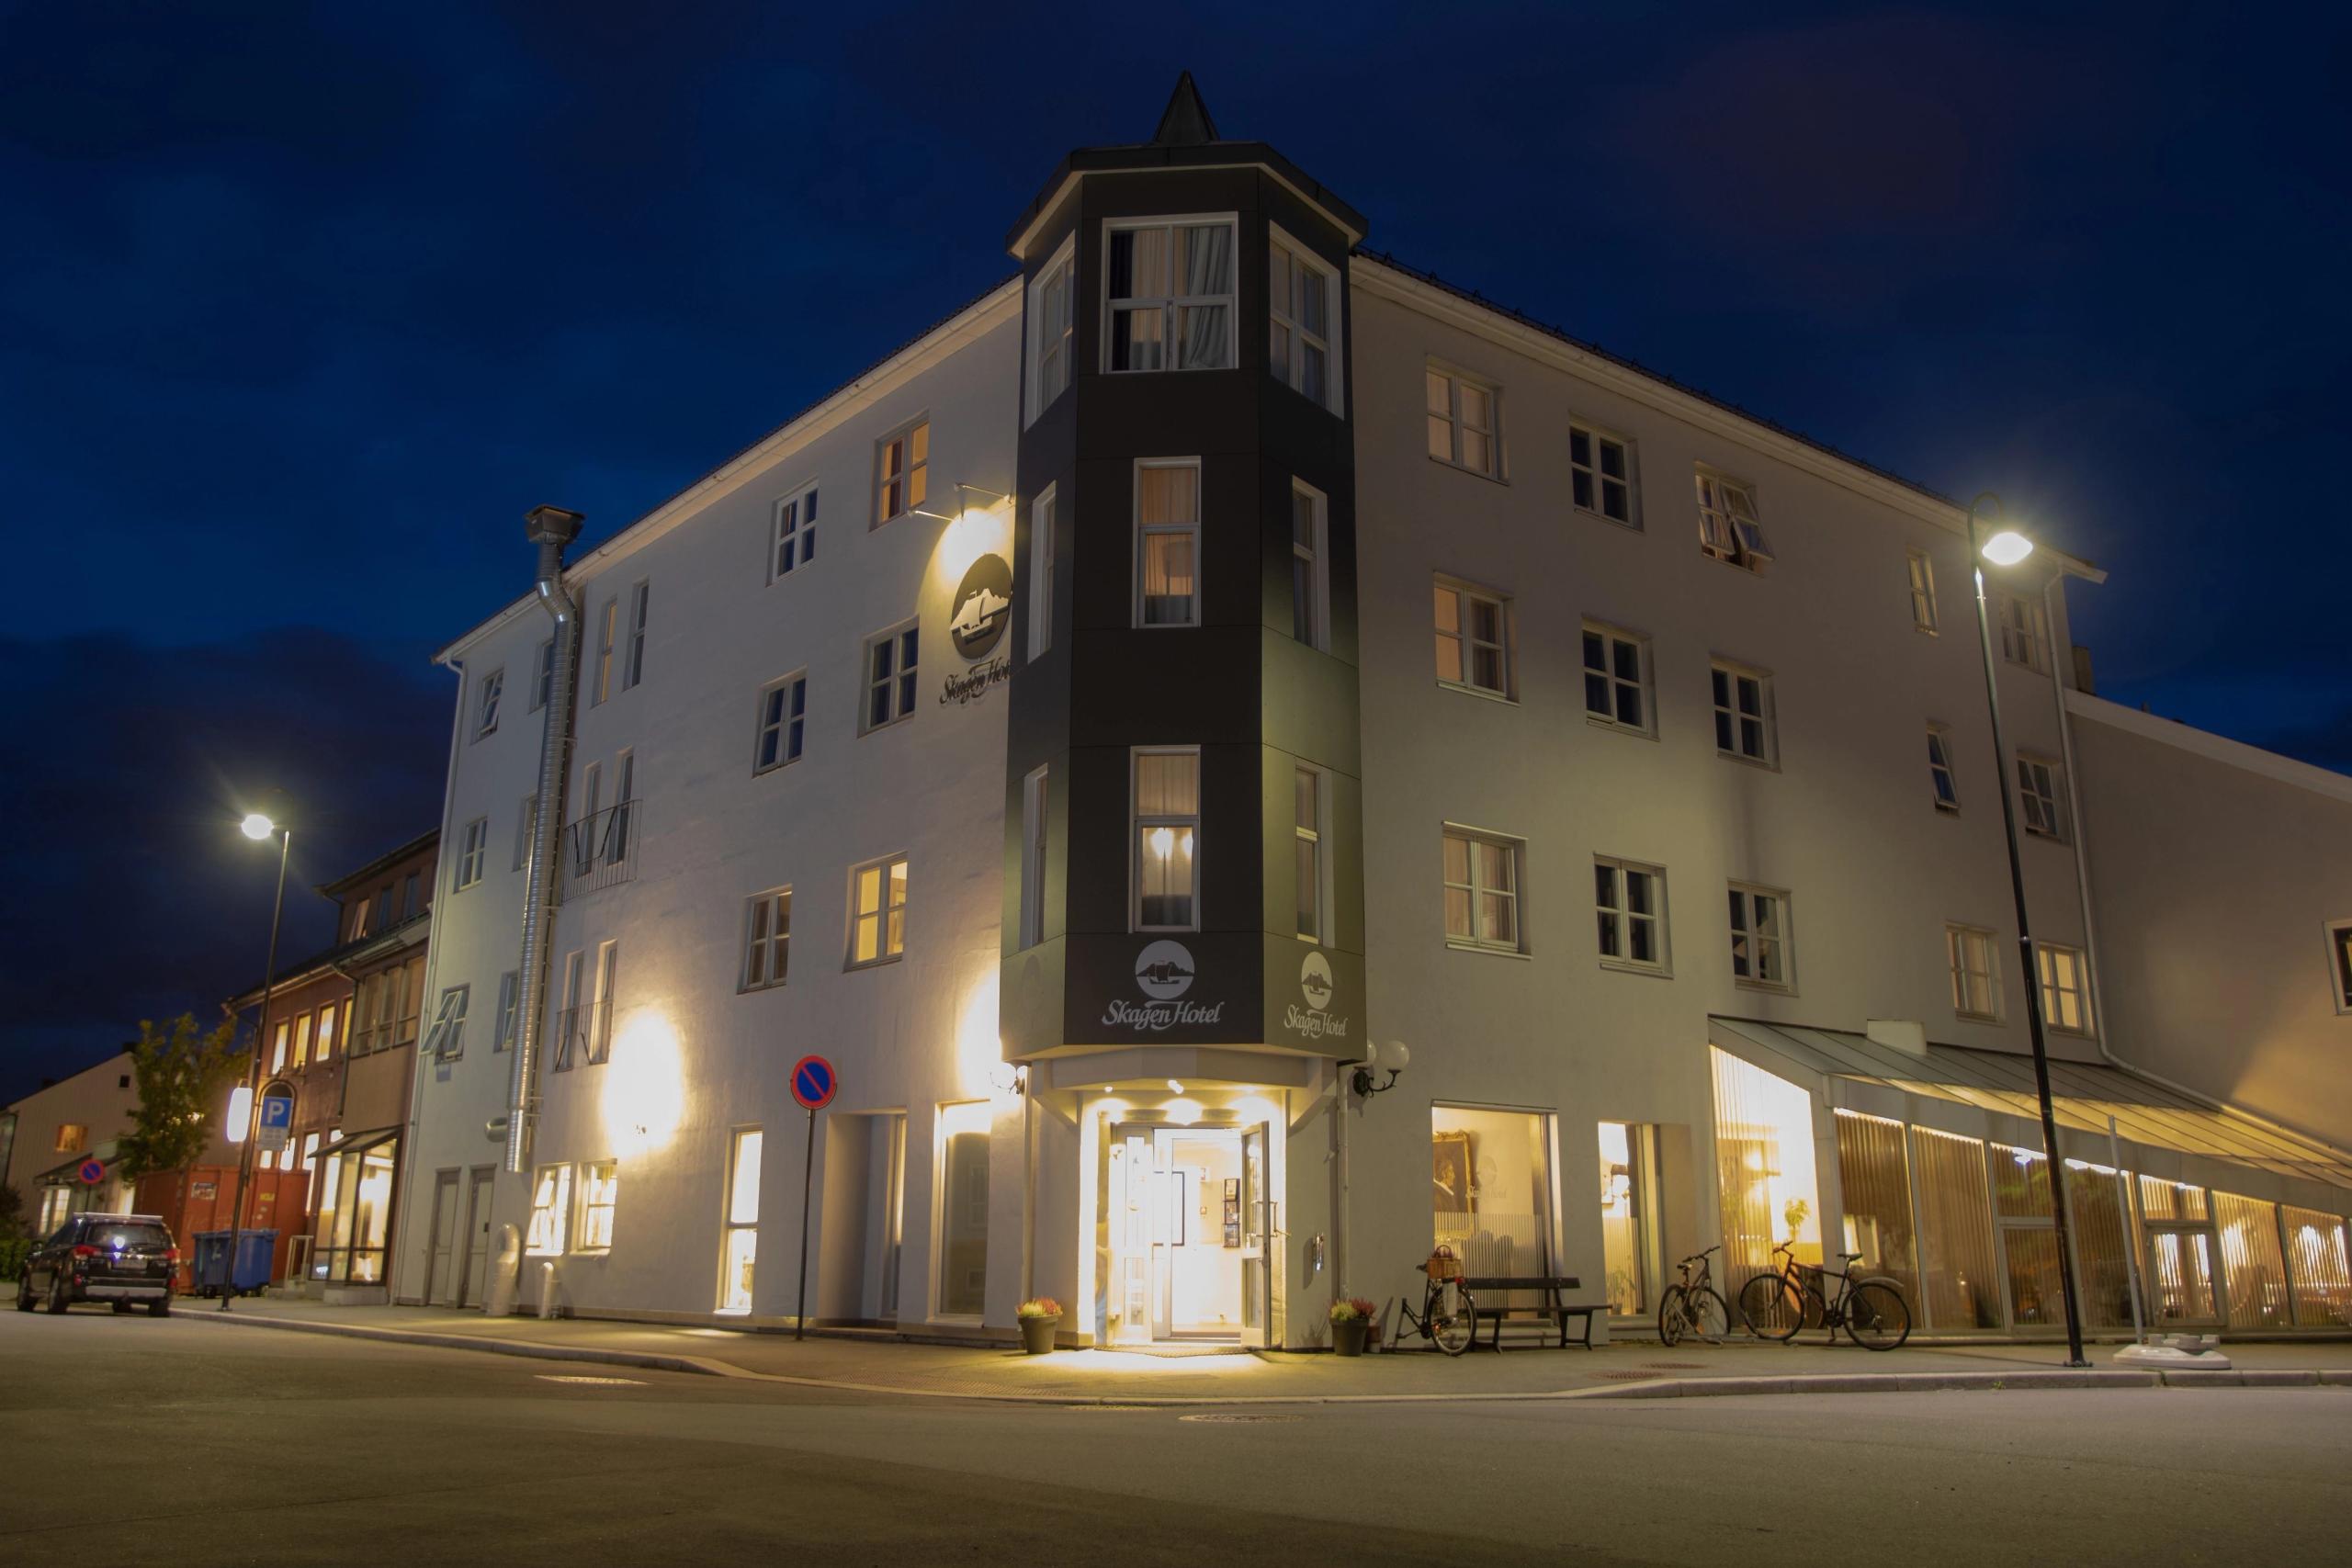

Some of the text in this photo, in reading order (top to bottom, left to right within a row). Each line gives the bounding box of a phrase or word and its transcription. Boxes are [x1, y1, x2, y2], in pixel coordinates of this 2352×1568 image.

[1102, 999, 1225, 1030] Skagen Hotel
[1283, 1004, 1348, 1039] Skagen Hotel
[267, 1101, 285, 1124] P
